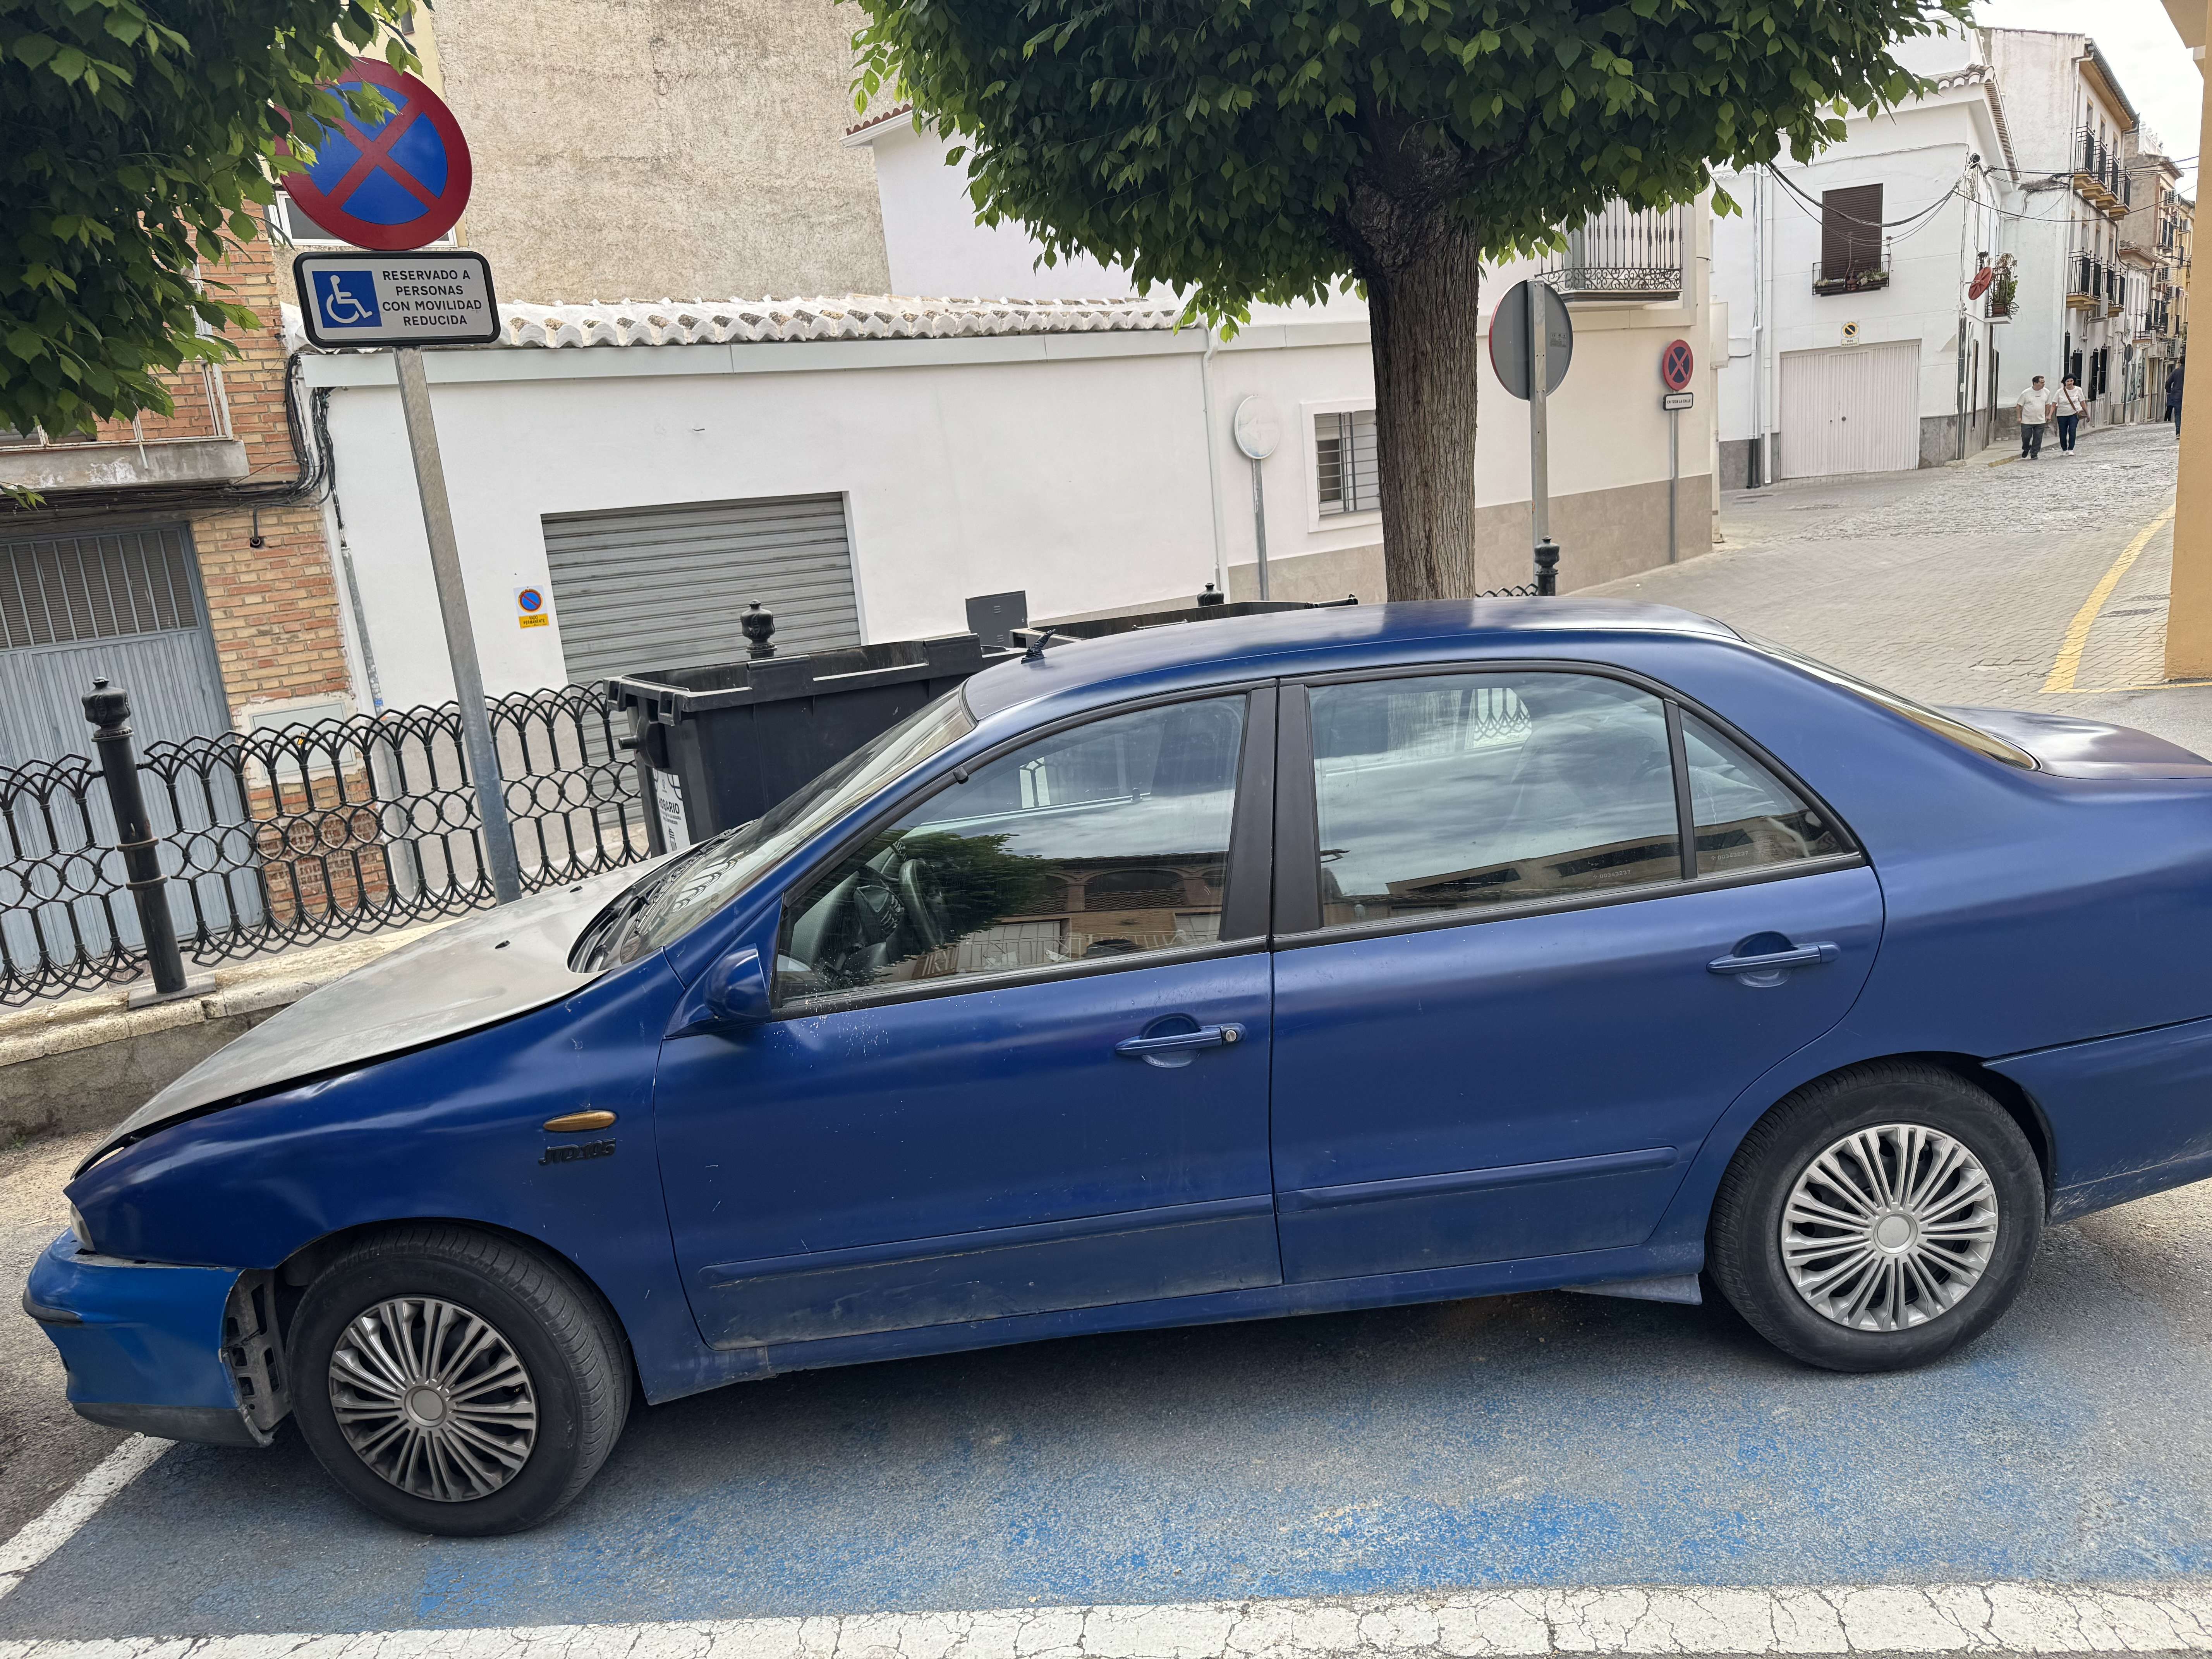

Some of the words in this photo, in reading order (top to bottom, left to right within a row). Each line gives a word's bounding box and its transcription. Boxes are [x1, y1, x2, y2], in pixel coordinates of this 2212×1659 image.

[382, 270, 458, 280] RESERVADO
[463, 270, 471, 280] A
[395, 285, 464, 296] PERSONAS
[382, 301, 410, 311] CON
[415, 300, 482, 310] MOVILIDAD
[403, 315, 467, 326] REDUCIDA
[659, 797, 680, 814] HORARIO
